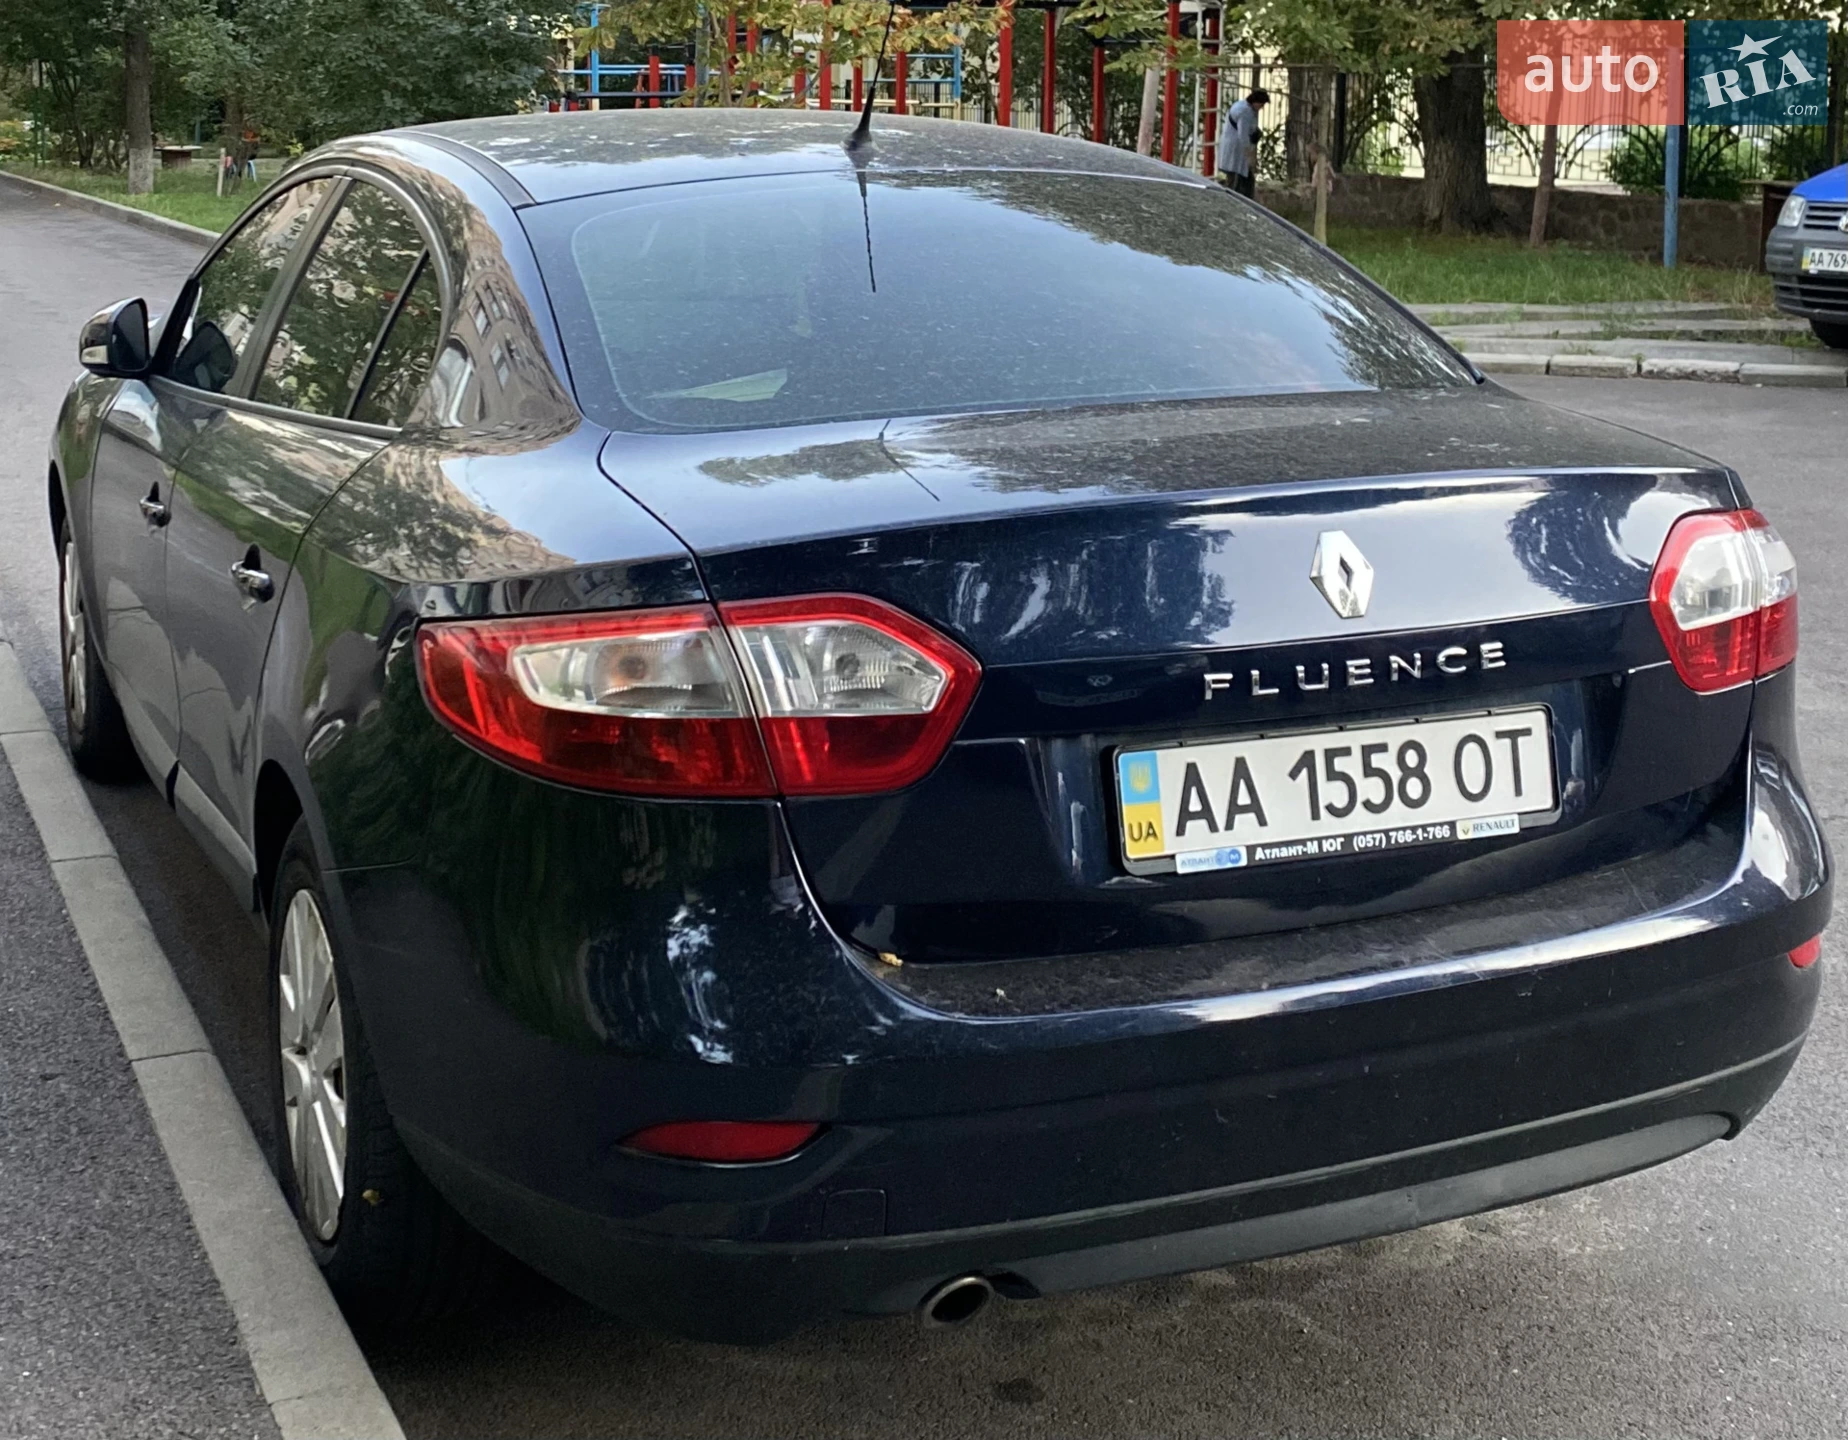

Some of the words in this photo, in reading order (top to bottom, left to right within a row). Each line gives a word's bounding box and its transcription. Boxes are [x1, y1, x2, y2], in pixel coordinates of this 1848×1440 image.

[1809, 251, 1825, 267] AA
[1827, 252, 1848, 269] 769
[1203, 641, 1507, 700] FLUENCE
[1175, 755, 1268, 837] AA
[1287, 738, 1432, 821] 1558
[1453, 727, 1533, 803] OT
[1128, 821, 1159, 843] UA
[1472, 818, 1517, 833] RENAULT
[1254, 840, 1320, 861] Атлант-М
[1321, 837, 1345, 853] ЮГ
[1352, 832, 1387, 852] (057)
[1388, 824, 1451, 845] 766-1-766
